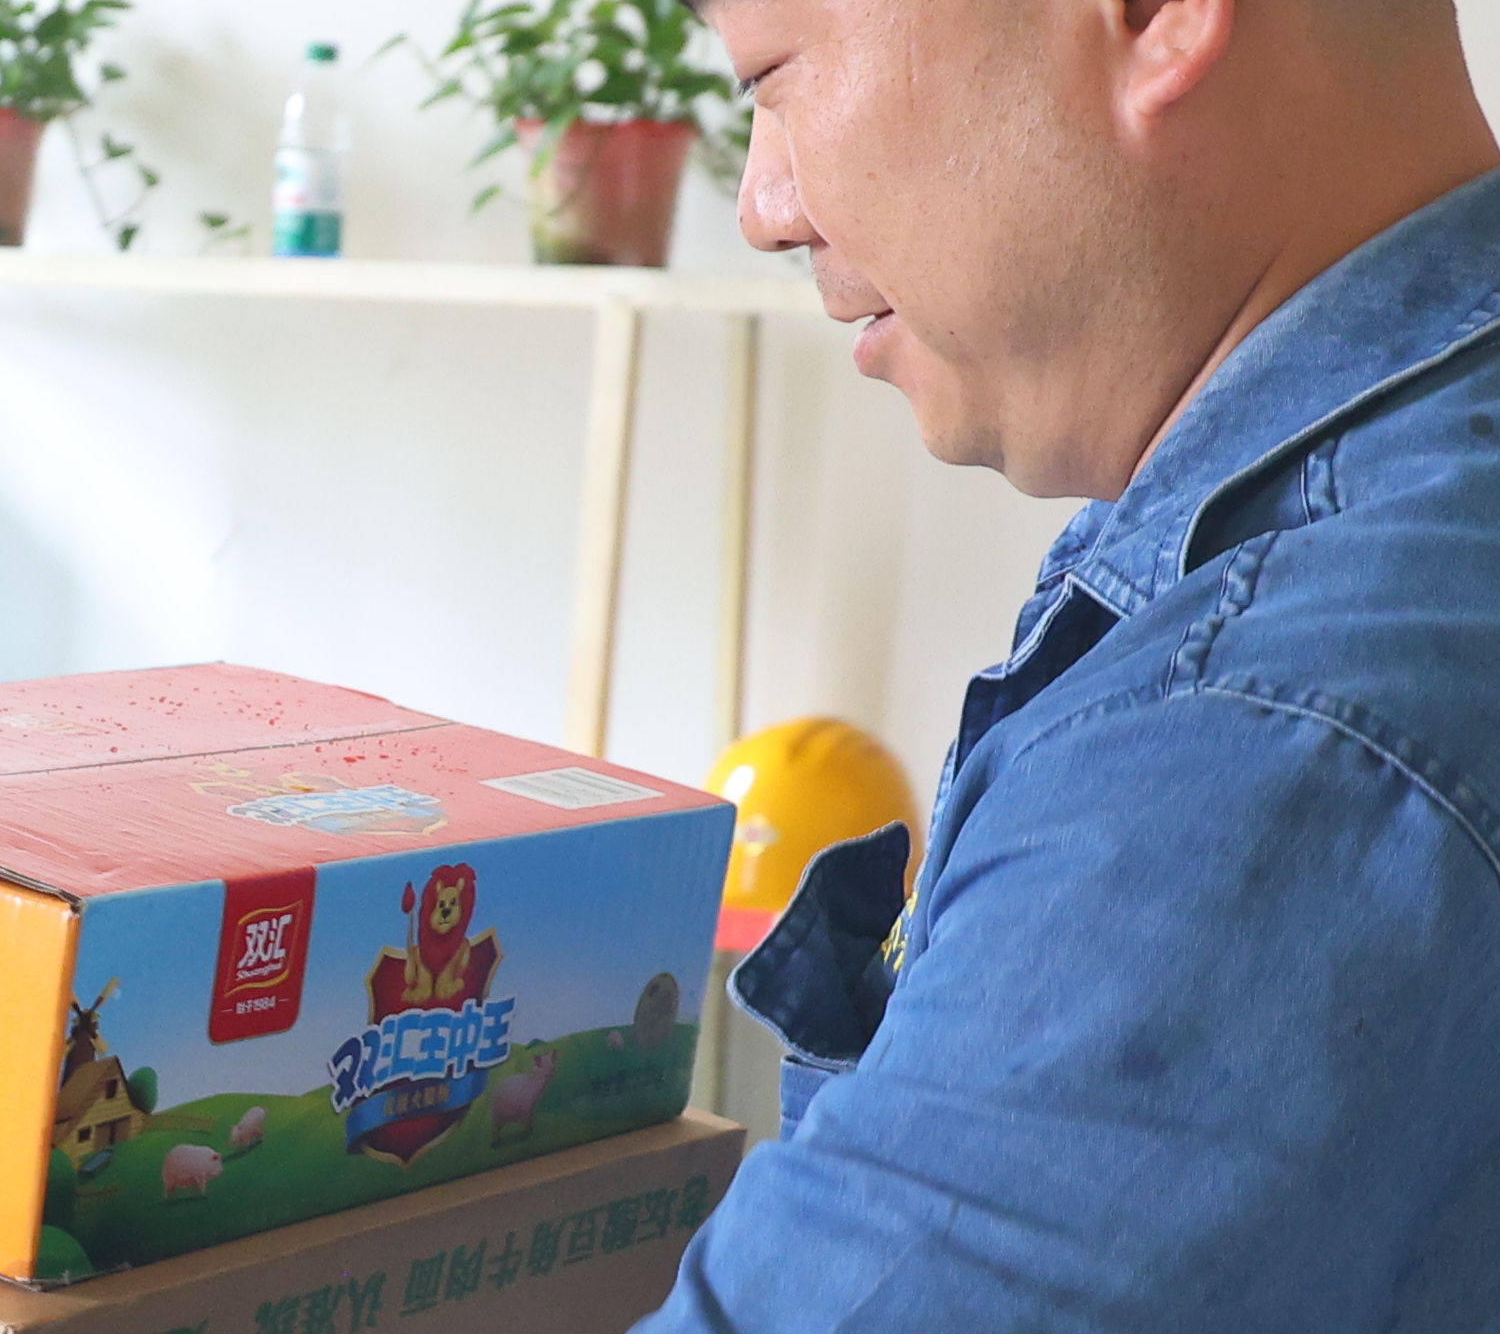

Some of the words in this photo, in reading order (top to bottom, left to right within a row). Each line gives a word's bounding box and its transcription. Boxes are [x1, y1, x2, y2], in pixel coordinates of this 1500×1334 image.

[237, 913, 293, 968] 双汇
[328, 997, 515, 1114] 双汇王中王
